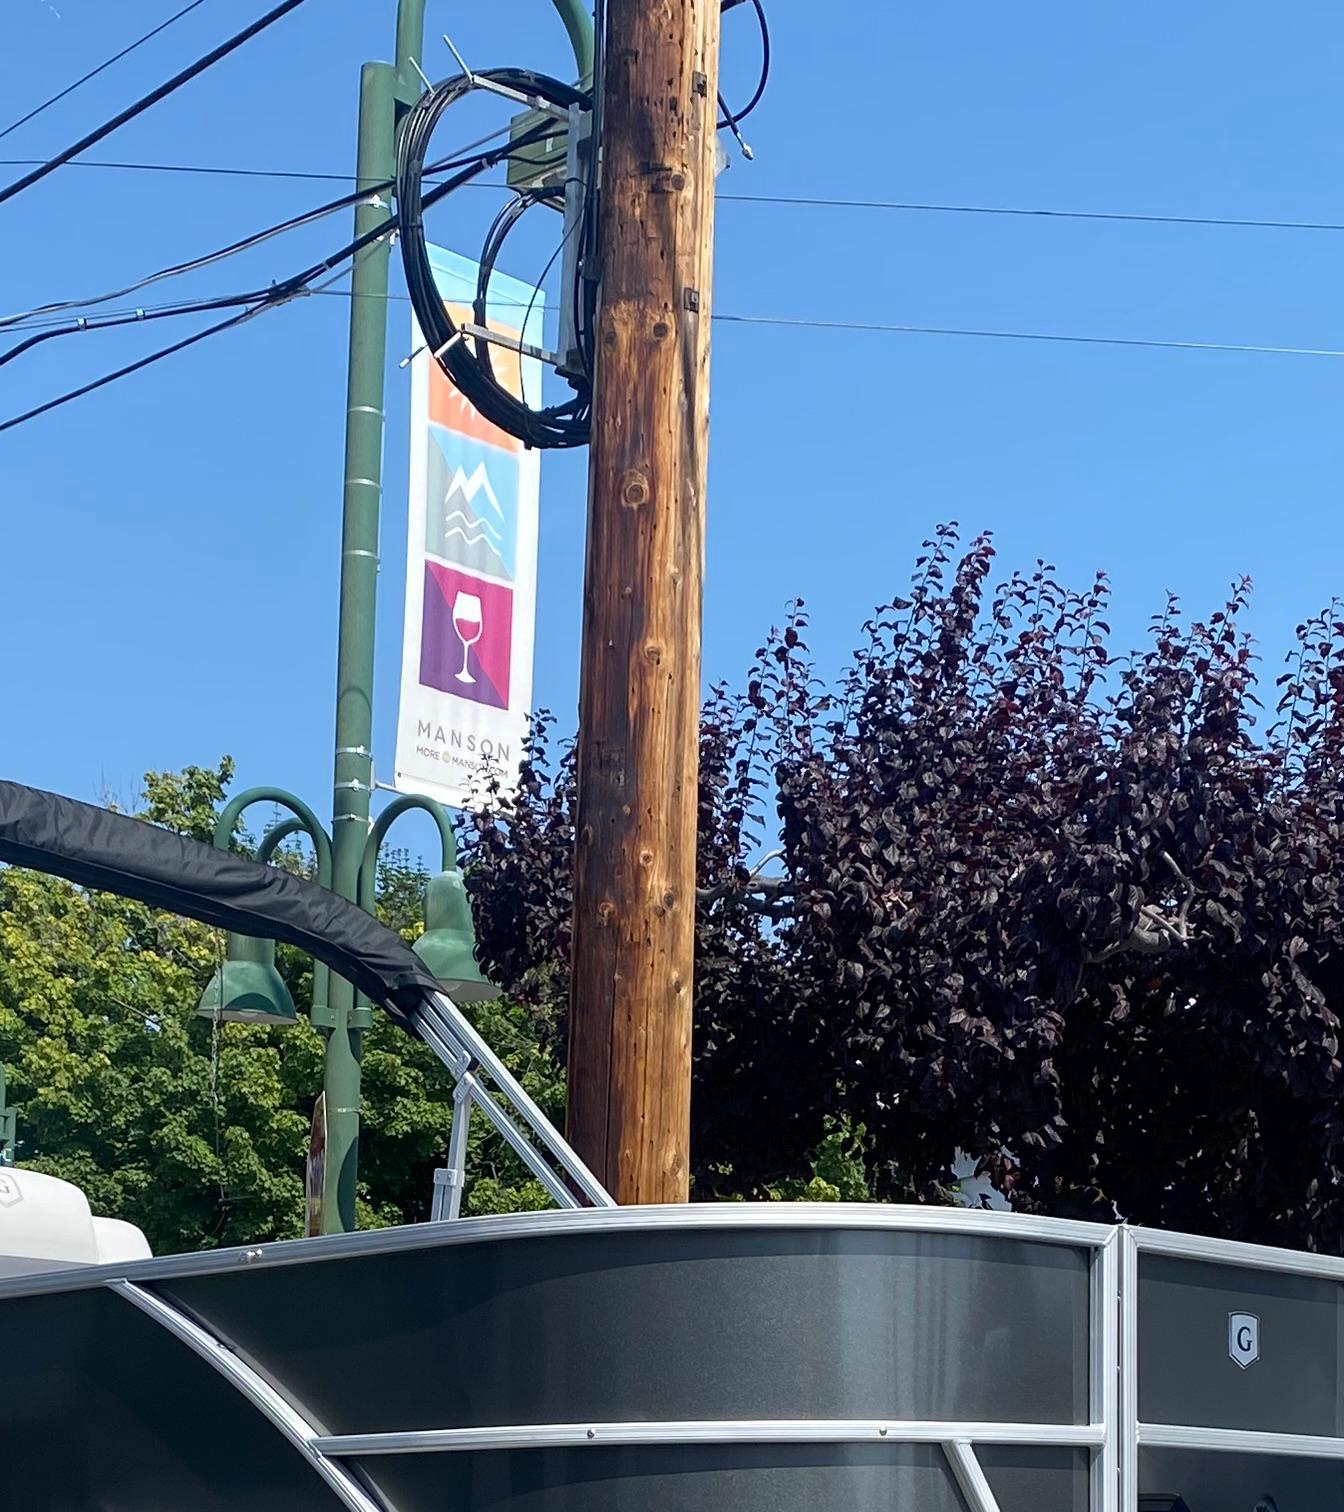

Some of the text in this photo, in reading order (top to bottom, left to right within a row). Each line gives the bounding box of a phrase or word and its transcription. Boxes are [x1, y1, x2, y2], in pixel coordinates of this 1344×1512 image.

[416, 745, 441, 761] MORE
[417, 719, 510, 761] MANSON
[1237, 1326, 1253, 1352] G
